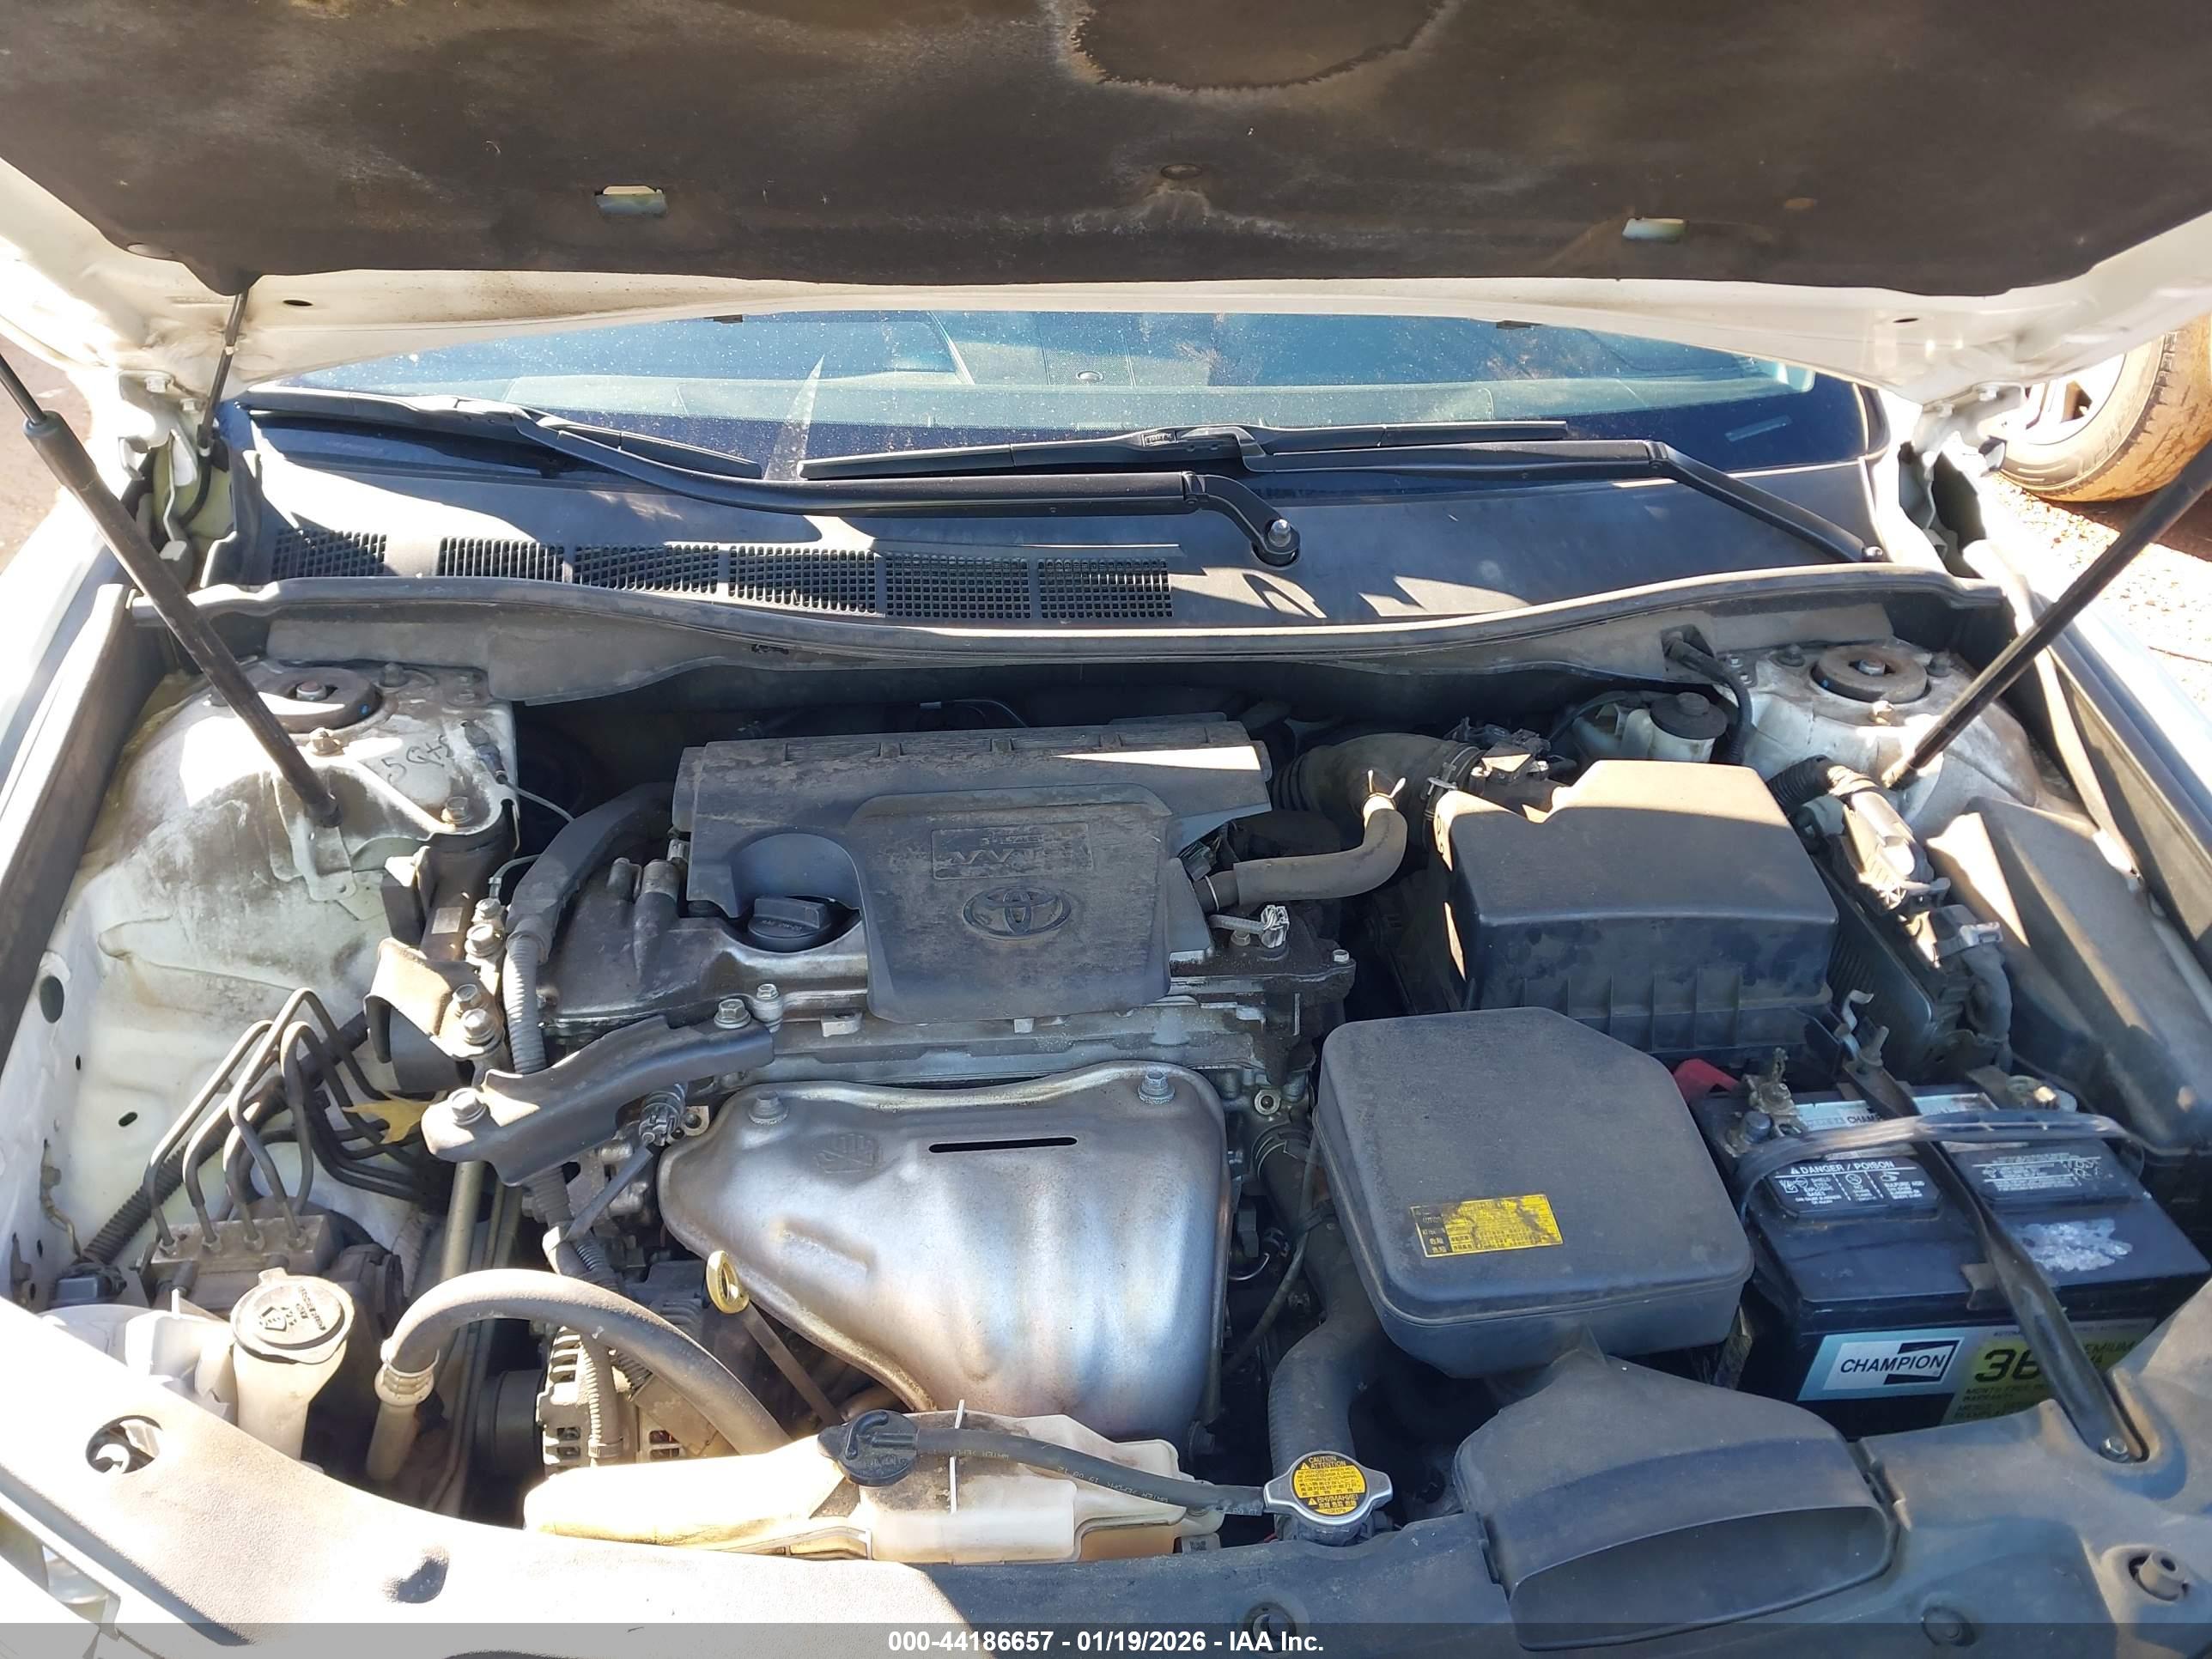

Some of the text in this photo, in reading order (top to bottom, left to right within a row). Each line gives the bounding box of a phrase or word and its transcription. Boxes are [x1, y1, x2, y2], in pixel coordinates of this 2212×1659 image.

[1799, 1164, 1844, 1175] DANGER
[1853, 1160, 1895, 1170] POISON
[1840, 1354, 1947, 1373] CHAMPION
[1975, 1348, 2042, 1383] 36
[1310, 1461, 1346, 1469] ATTENTION
